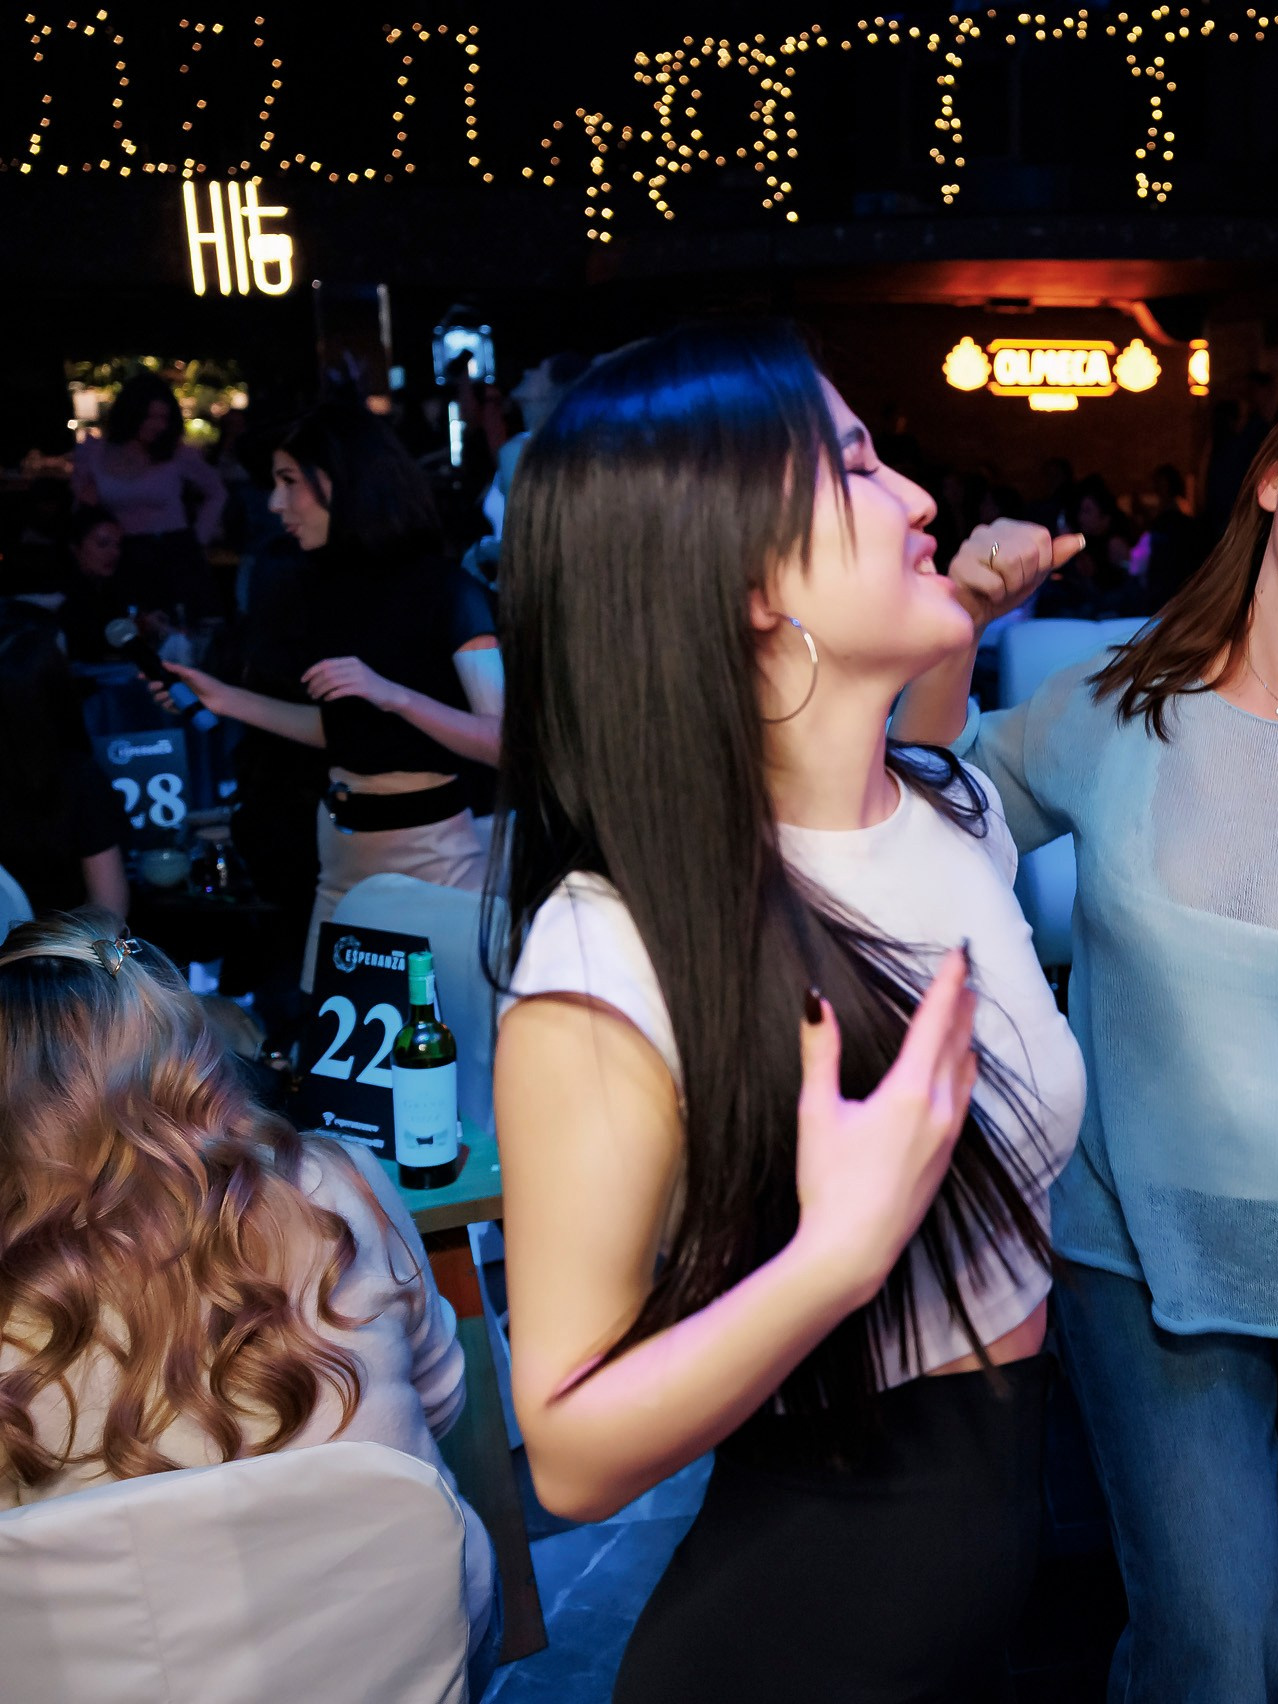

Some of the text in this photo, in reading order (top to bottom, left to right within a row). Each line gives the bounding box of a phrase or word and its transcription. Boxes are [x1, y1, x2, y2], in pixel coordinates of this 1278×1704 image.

[993, 349, 1112, 387] OLMECA
[345, 949, 406, 971] ESPERANZA
[310, 995, 404, 1089] 22
